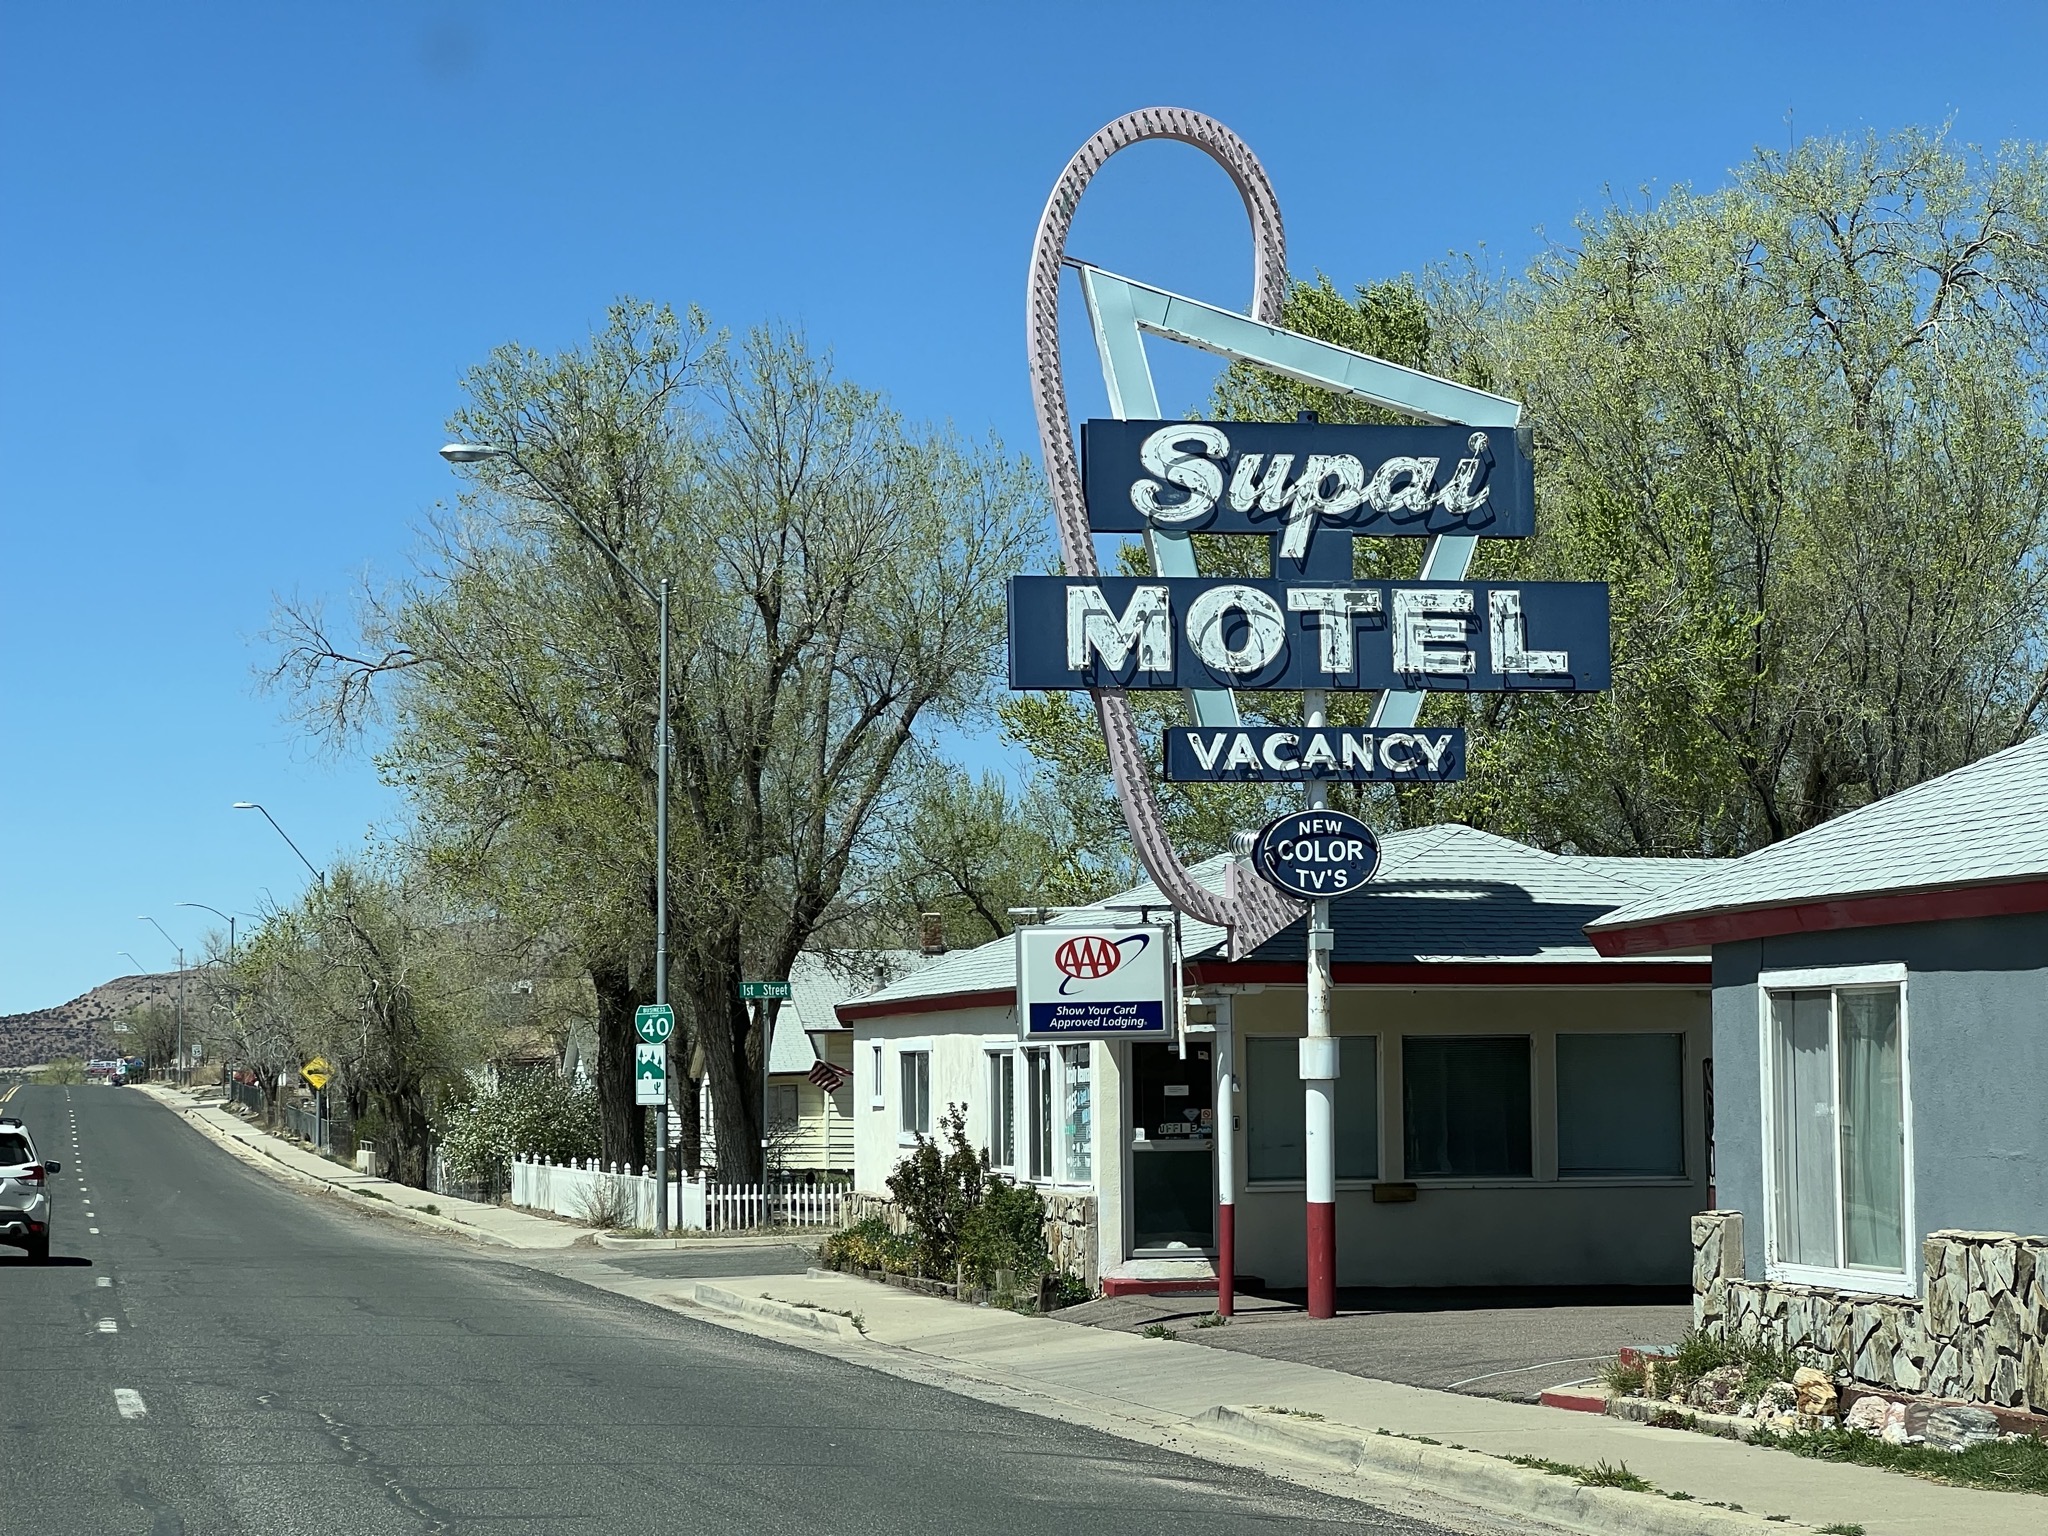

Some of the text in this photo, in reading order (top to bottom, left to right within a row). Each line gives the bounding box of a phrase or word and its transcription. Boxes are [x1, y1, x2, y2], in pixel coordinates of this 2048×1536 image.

[1130, 424, 1491, 558] Supai
[1066, 584, 1570, 675] MOTEL
[1186, 732, 1453, 773] VACANCY
[1298, 819, 1342, 836] NEW
[1277, 839, 1364, 862] COLOR
[1295, 868, 1348, 889] TV'S
[1062, 937, 1117, 979] AAA
[743, 984, 788, 996] 1st Street
[1056, 1004, 1138, 1016] Show Your Card
[641, 1017, 669, 1036] 40
[1049, 1016, 1101, 1030] Approved
